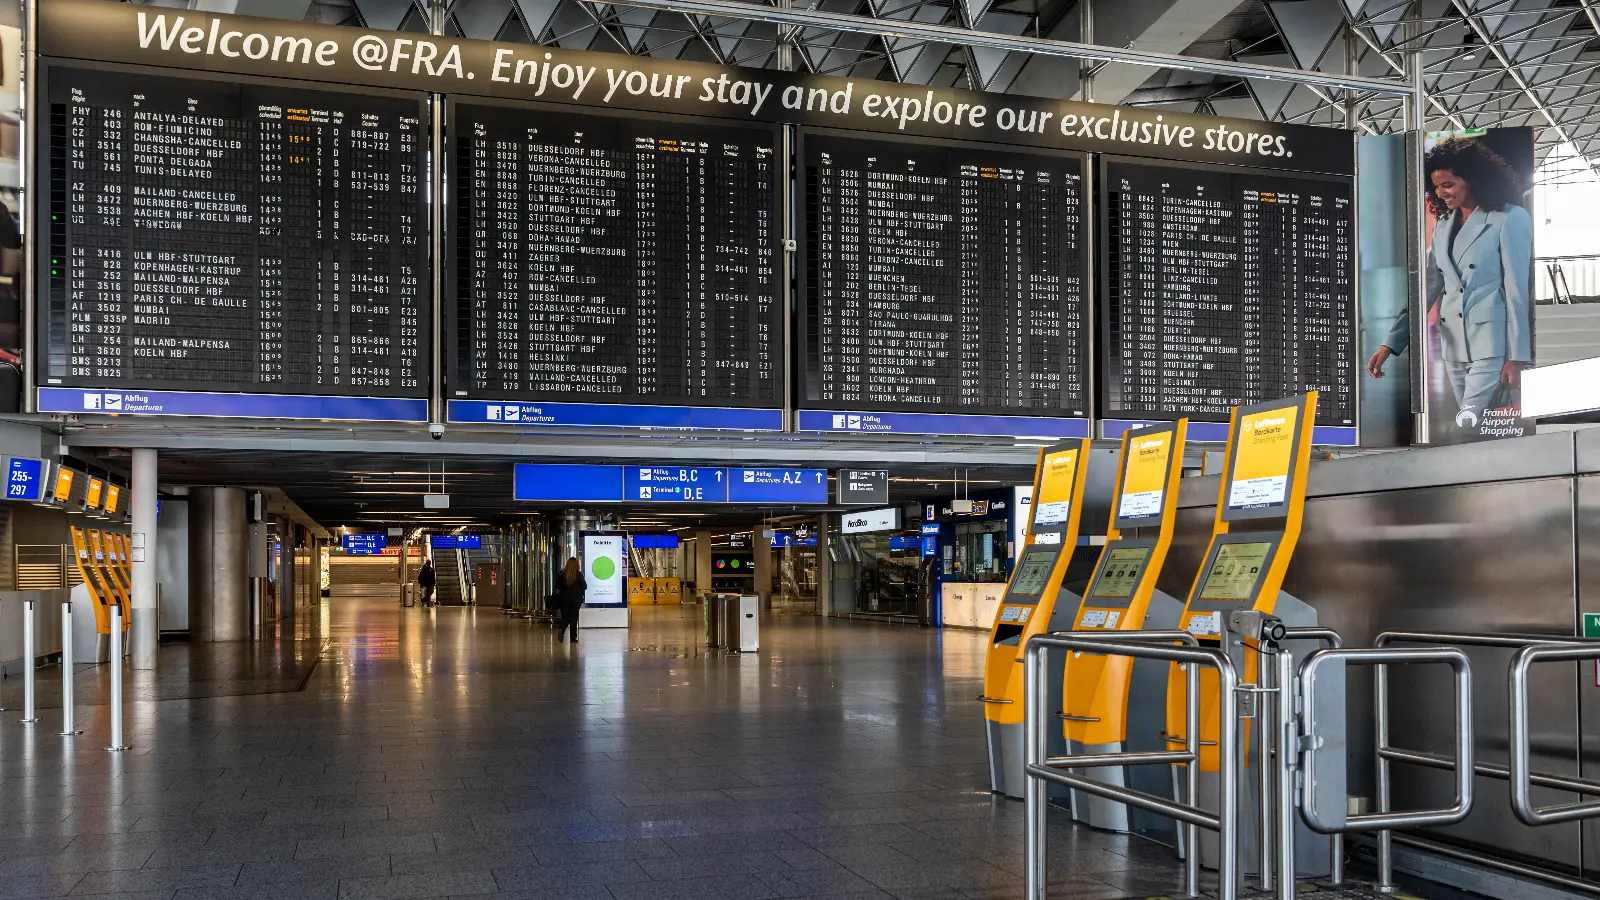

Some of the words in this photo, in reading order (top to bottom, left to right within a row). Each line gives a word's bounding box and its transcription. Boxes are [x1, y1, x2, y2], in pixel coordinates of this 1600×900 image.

[137, 12, 339, 66] Welcome
[352, 34, 475, 80] @FRA.
[490, 48, 597, 101] Enjoy
[603, 68, 692, 103] your
[698, 73, 774, 116] stay
[781, 81, 854, 115] and
[862, 90, 987, 130] explore
[996, 107, 1054, 134] our
[1060, 109, 1196, 148] exclusive
[1202, 124, 1293, 158] stores.
[72, 106, 91, 116] FHY
[103, 108, 122, 119] 246
[133, 111, 224, 127] ANTALYA-DELAYED
[351, 129, 389, 141] 886-887
[400, 134, 412, 143] E3
[71, 117, 85, 126] AZ
[103, 119, 122, 129] 403
[351, 140, 390, 151] 719-722
[400, 144, 411, 153] B9
[72, 127, 85, 137] CZ
[103, 130, 122, 140] 332
[134, 132, 242, 149] CHANGSHA-CANCELLED
[97, 140, 121, 151] 3514
[133, 143, 200, 157] DUESSELDORF
[206, 149, 224, 158] HBF
[400, 164, 412, 173] T7
[72, 149, 84, 159] S4
[103, 152, 121, 162] 561
[134, 154, 165, 165] PONTA
[170, 157, 212, 168] DELGADA
[351, 170, 390, 182] 811-813
[401, 174, 417, 184] E24
[72, 160, 85, 170] TU
[103, 162, 121, 172] 745
[134, 165, 212, 179] TUNIS-DELAYED
[351, 181, 390, 192] 537-539
[72, 182, 85, 191] AZ
[103, 184, 122, 194] 409
[72, 193, 85, 202] LH
[96, 194, 121, 205] 3472
[400, 215, 412, 224] T4
[72, 203, 85, 213] LH
[97, 205, 121, 215] 3538
[133, 208, 171, 219] AACHEN
[176, 210, 230, 222] HBF-KOELN
[235, 214, 253, 224] HBF
[97, 248, 121, 259] 3416
[134, 251, 152, 260] ULM
[158, 252, 236, 265] HBF-STUTTGART
[103, 260, 121, 269] 828
[134, 261, 241, 276] KOPENHAGEN-KASTRUP
[103, 271, 121, 280] 252
[71, 291, 84, 300] AF
[98, 292, 121, 302] 1219
[133, 294, 164, 304] PARIS
[170, 295, 187, 305] CH.
[194, 297, 206, 306] DE
[212, 297, 247, 308] GAULLE
[351, 304, 390, 315] 801-805
[401, 307, 417, 316] E23
[71, 302, 83, 311] AI
[97, 303, 121, 313] 3502
[103, 314, 127, 323] 935P
[134, 348, 165, 357] KOELN
[170, 349, 188, 358] HBF
[401, 358, 412, 367] T6
[124, 394, 148, 403] Abflug
[124, 404, 164, 412] Departures
[521, 406, 542, 414] Abflug
[1482, 417, 1516, 427] Airport
[1480, 426, 1524, 437] Shopping
[11, 470, 32, 482] 255-
[680, 469, 698, 482] B,C
[783, 471, 802, 484] A,Z
[10, 485, 27, 496] 297
[684, 487, 703, 500] D,E
